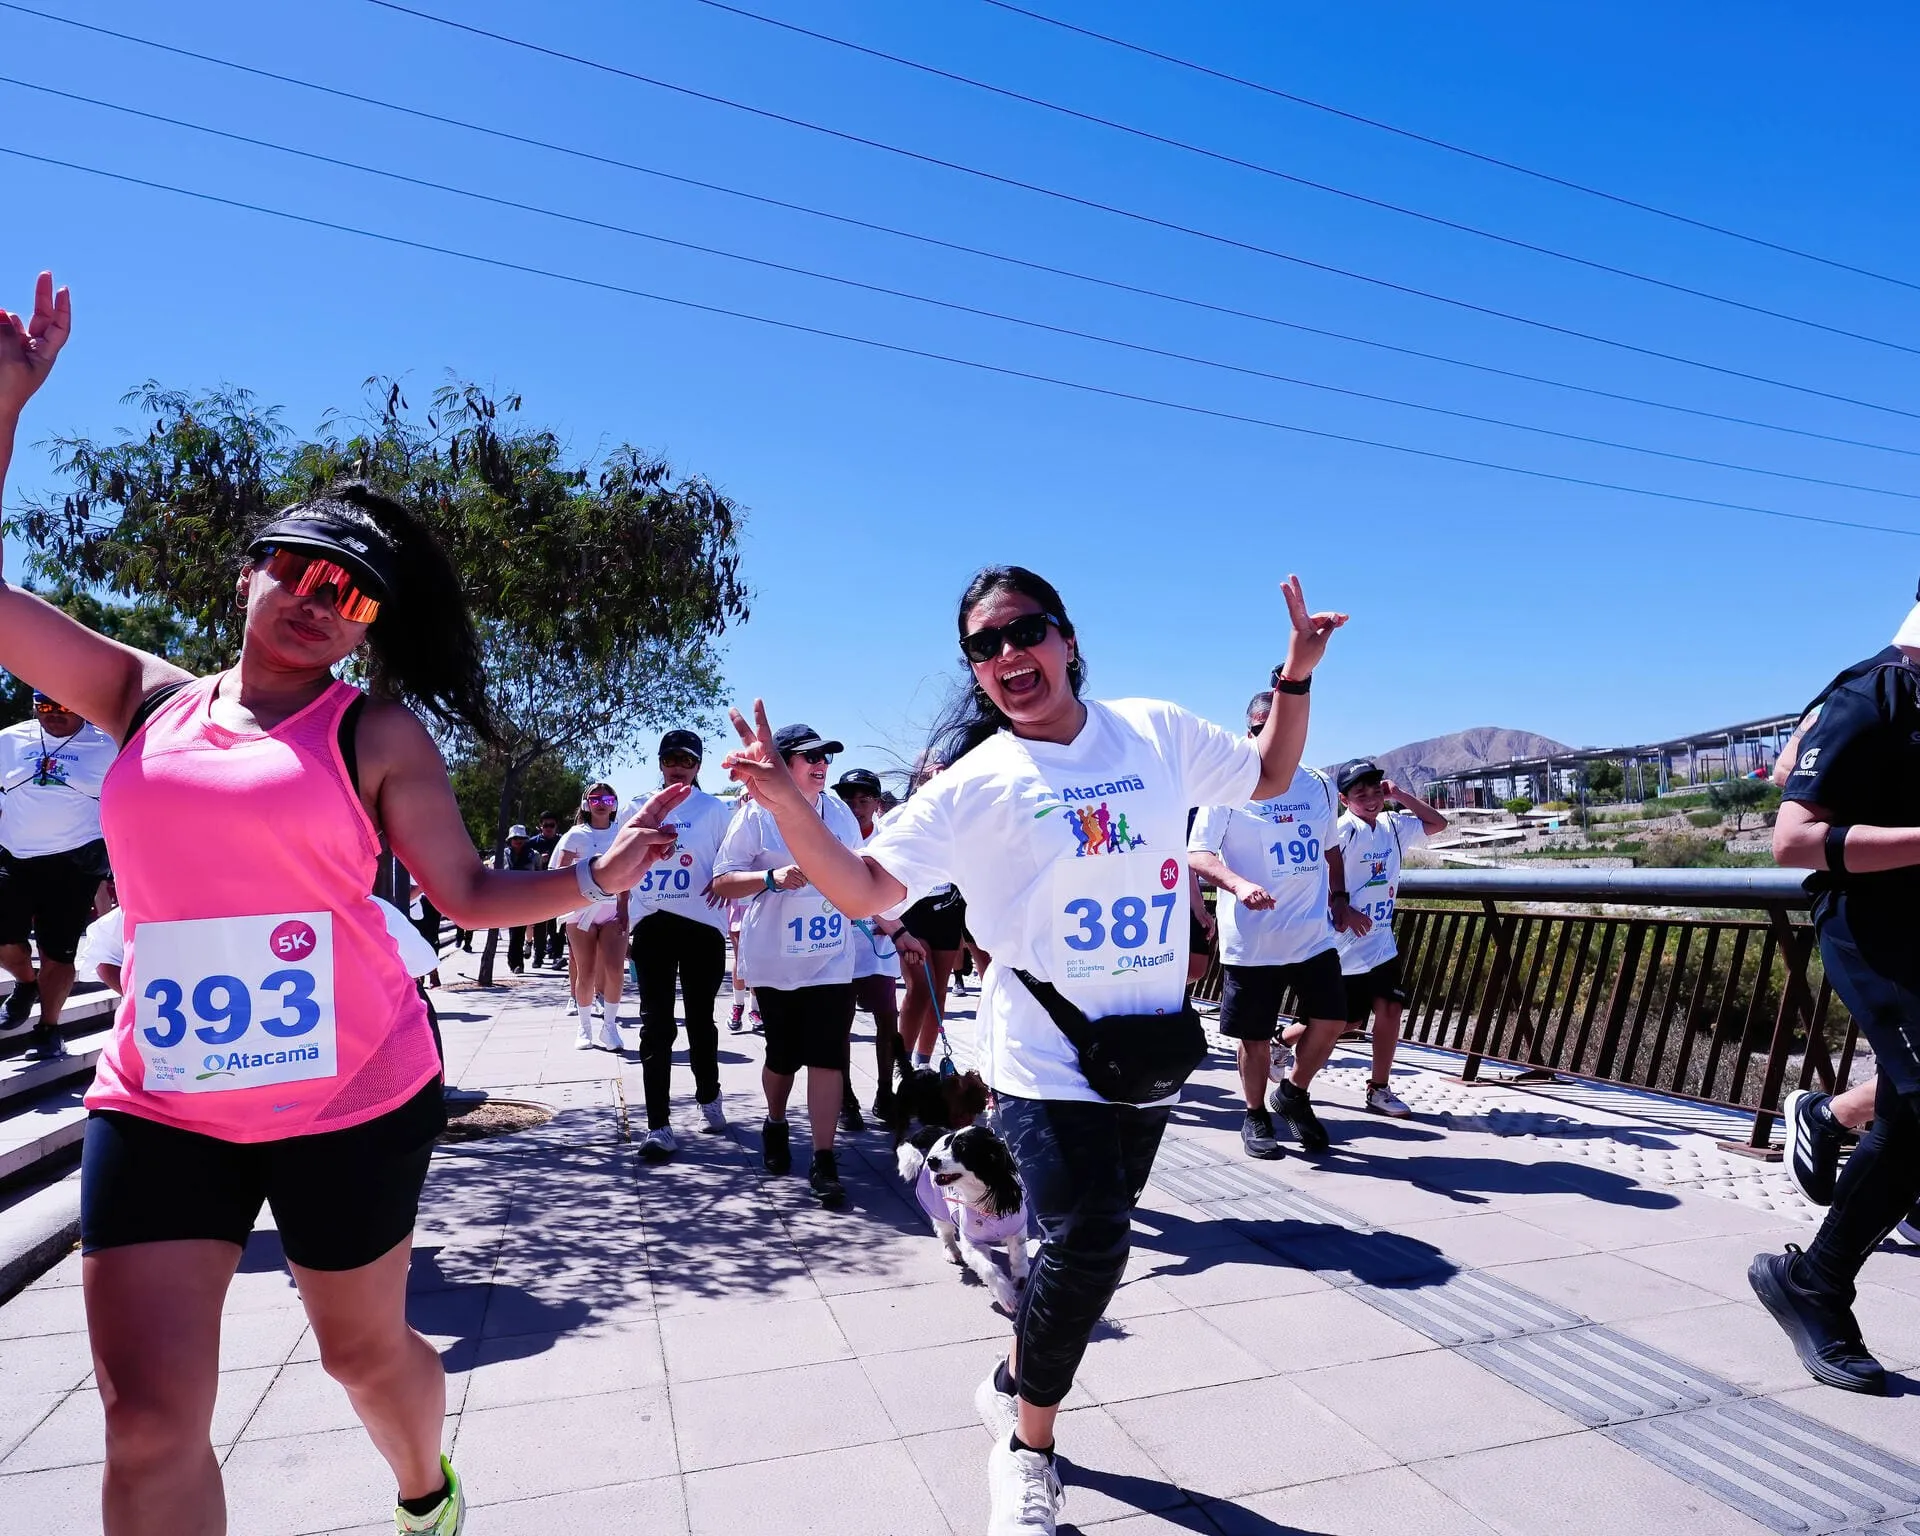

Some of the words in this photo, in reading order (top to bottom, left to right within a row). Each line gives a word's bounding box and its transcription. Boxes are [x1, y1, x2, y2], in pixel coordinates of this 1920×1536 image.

[1063, 778, 1145, 802] Atacama
[1274, 803, 1311, 812] Atacama
[1270, 839, 1320, 866] 190
[640, 869, 690, 892] 370
[1163, 867, 1176, 880] 3K
[788, 913, 842, 942] 189
[1064, 892, 1176, 951] 387
[278, 931, 311, 953] 5K
[1132, 952, 1175, 968] Atacama
[143, 969, 321, 1048] 393
[226, 1046, 319, 1070] Atacama
